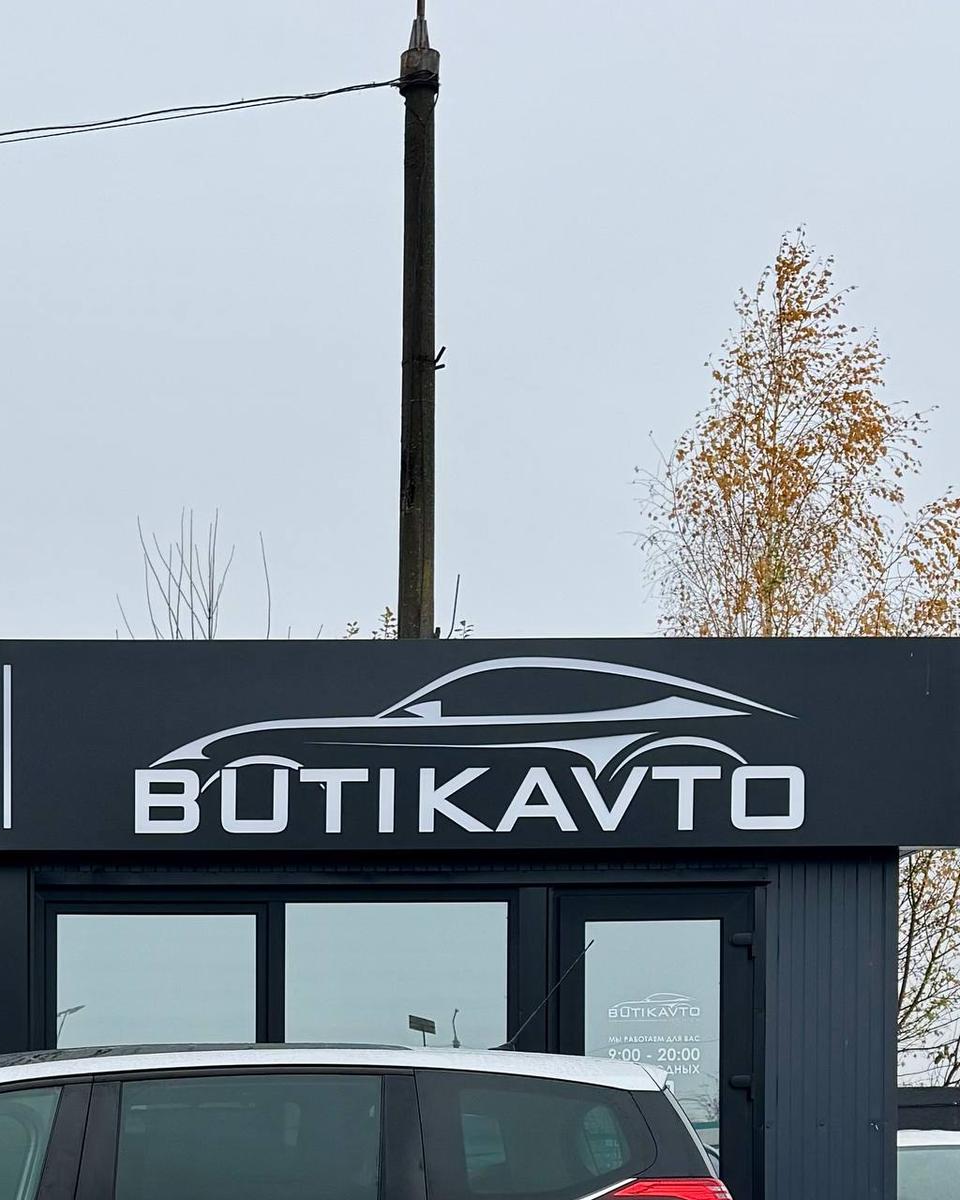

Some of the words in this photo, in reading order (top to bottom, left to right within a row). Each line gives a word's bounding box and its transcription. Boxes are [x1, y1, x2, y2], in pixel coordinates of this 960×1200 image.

[134, 765, 806, 836] BUTIKAVTO
[608, 1007, 701, 1018] BUTIKAVTO
[657, 1047, 701, 1062] 20:00
